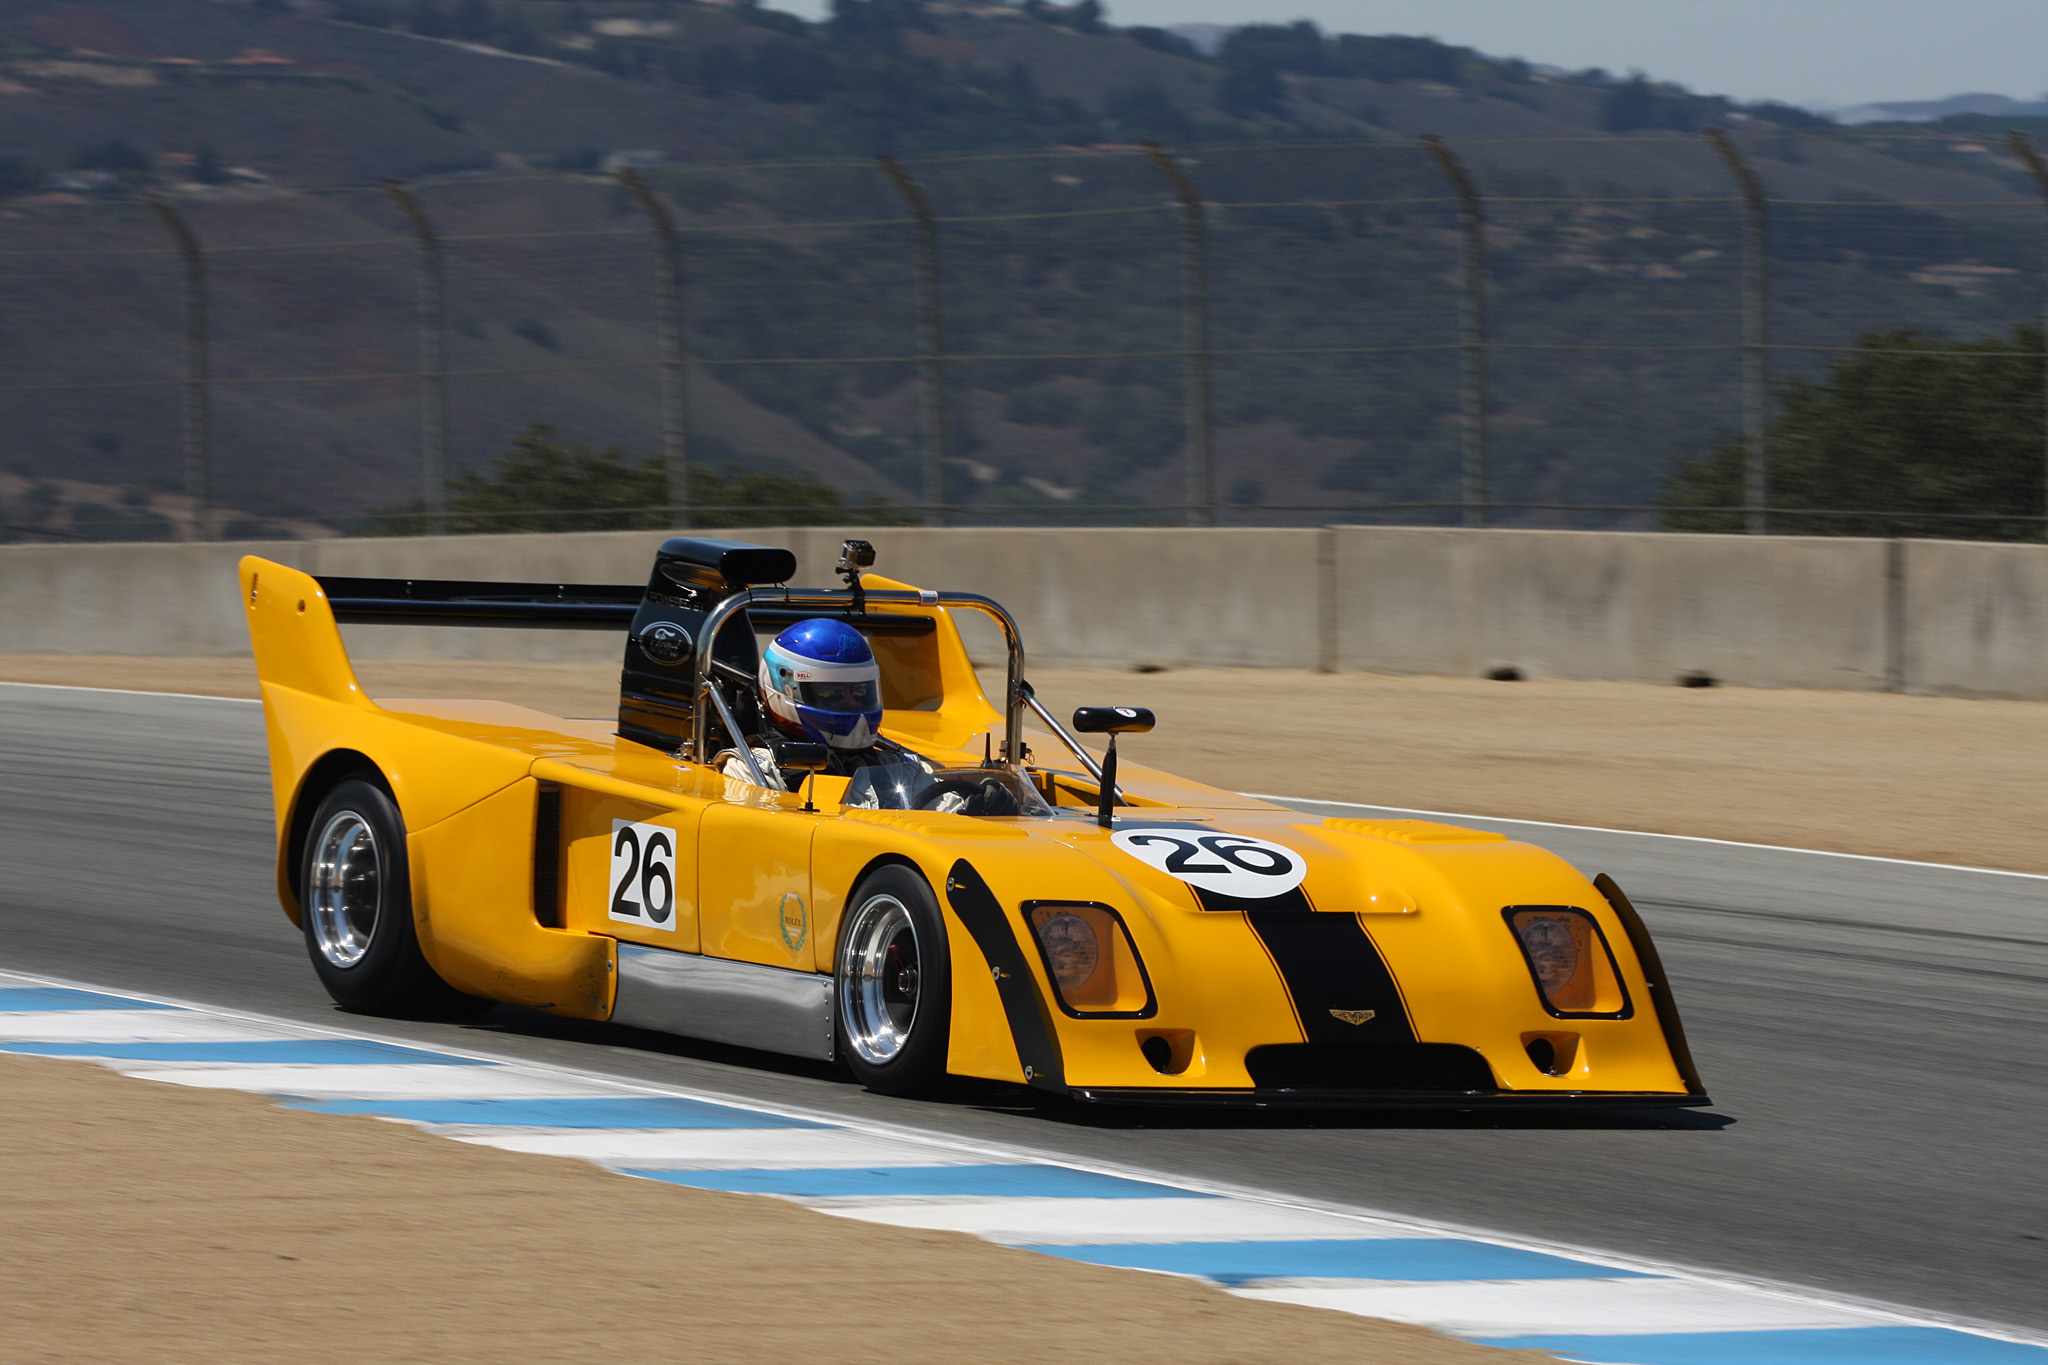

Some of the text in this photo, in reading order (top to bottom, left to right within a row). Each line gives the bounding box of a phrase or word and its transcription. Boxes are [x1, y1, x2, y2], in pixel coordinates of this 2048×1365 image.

[611, 826, 672, 923] 26
[1128, 835, 1293, 876] 26
[784, 916, 801, 927] ROLEX
